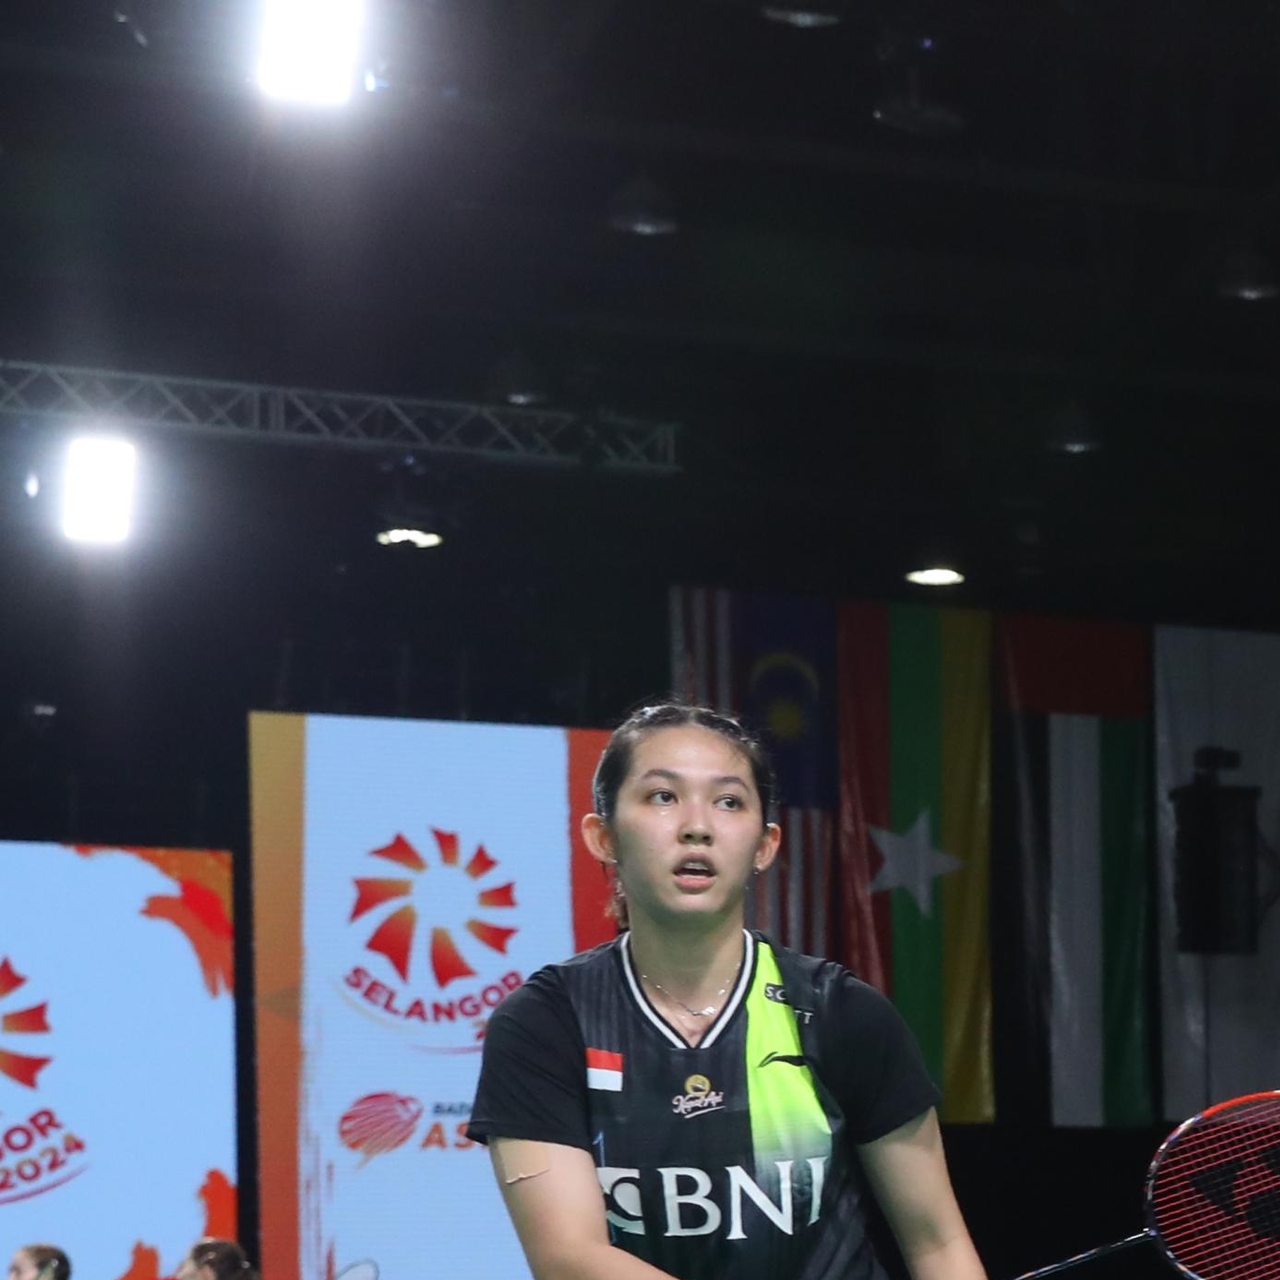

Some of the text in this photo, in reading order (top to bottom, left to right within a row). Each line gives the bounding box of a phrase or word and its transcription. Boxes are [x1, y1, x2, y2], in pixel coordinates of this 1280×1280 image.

[345, 965, 523, 1023] SELANGOR
[0, 1109, 61, 1159] OR
[657, 1156, 828, 1240] BNI
